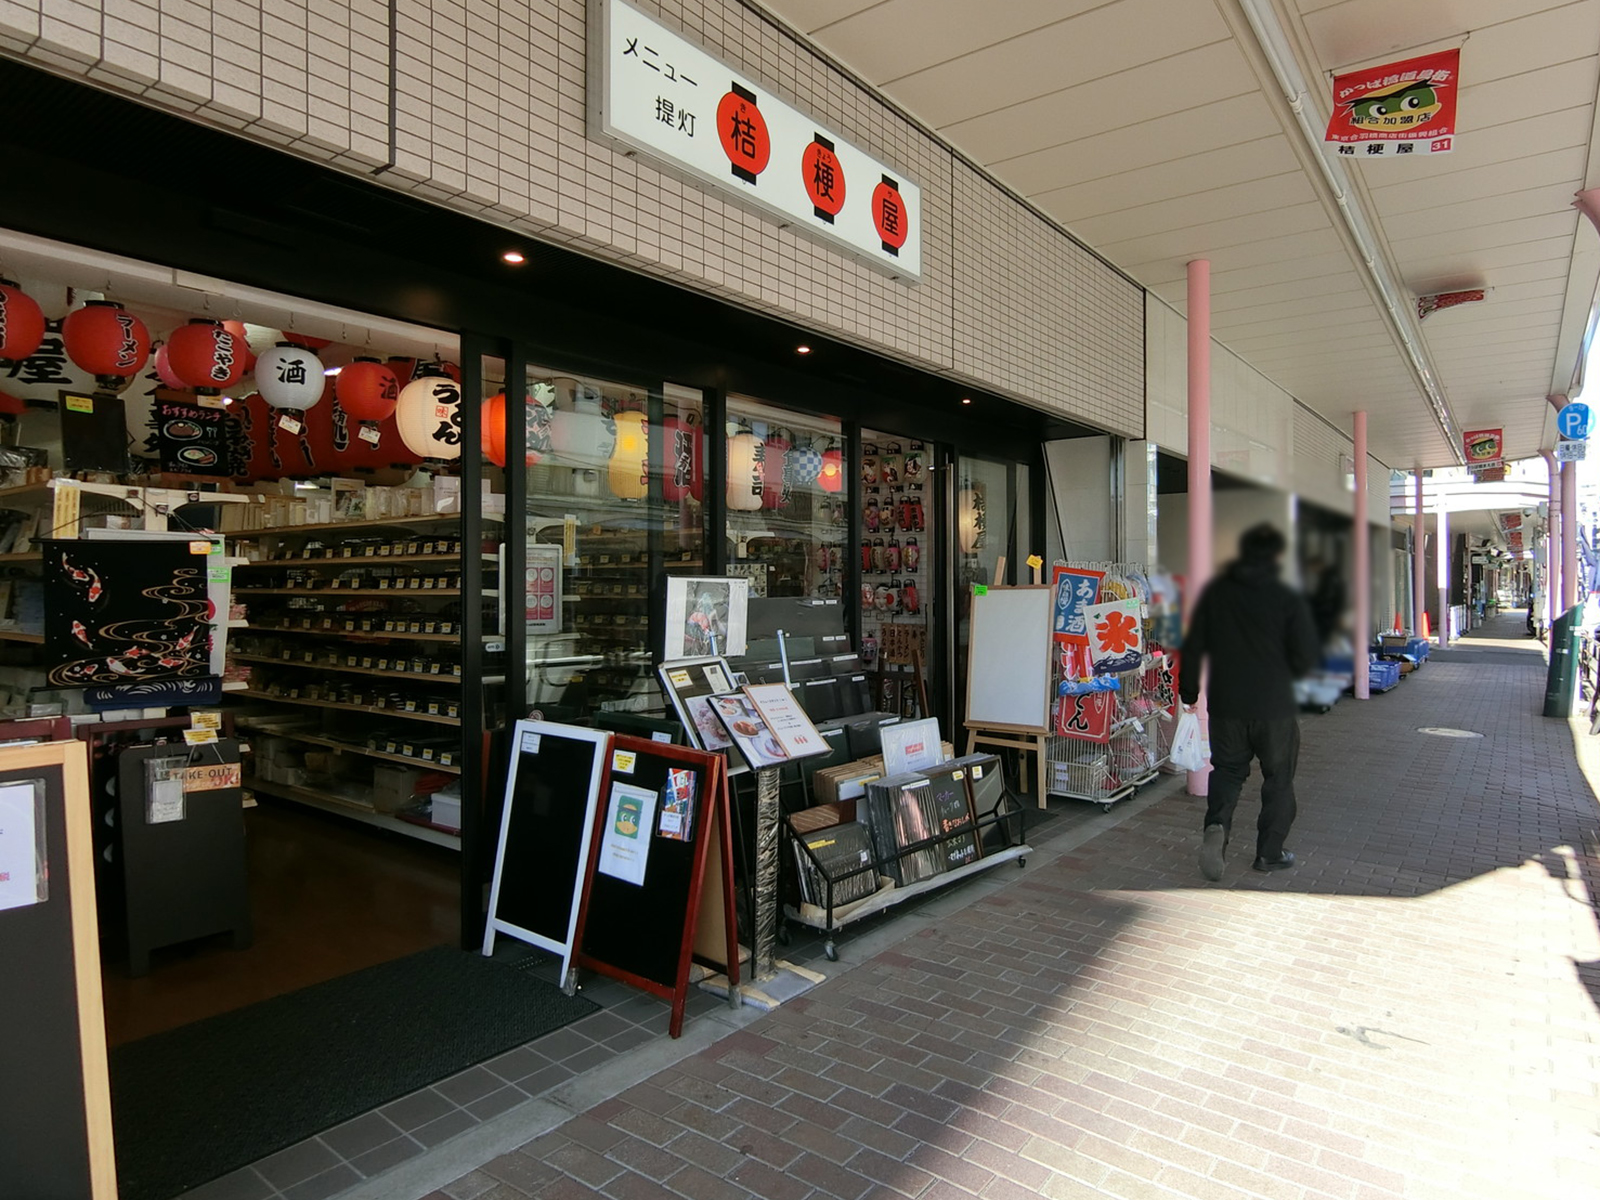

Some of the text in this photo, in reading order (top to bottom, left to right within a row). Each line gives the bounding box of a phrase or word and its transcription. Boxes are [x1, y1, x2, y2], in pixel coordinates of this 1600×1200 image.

[623, 37, 698, 87] メニュー
[655, 95, 696, 138] 提灯
[739, 102, 747, 115] き
[816, 148, 832, 164] きょう
[1350, 112, 1432, 126] 組合加盟店
[1338, 140, 1450, 155] 桔梗屋 31
[116, 314, 138, 367] ラーメン
[276, 357, 307, 386] 酒
[161, 404, 222, 422] おすすめランチ
[1566, 412, 1582, 436] P
[1576, 424, 1588, 436] 60
[1065, 578, 1094, 633] あま酒
[1093, 610, 1140, 654] 氷
